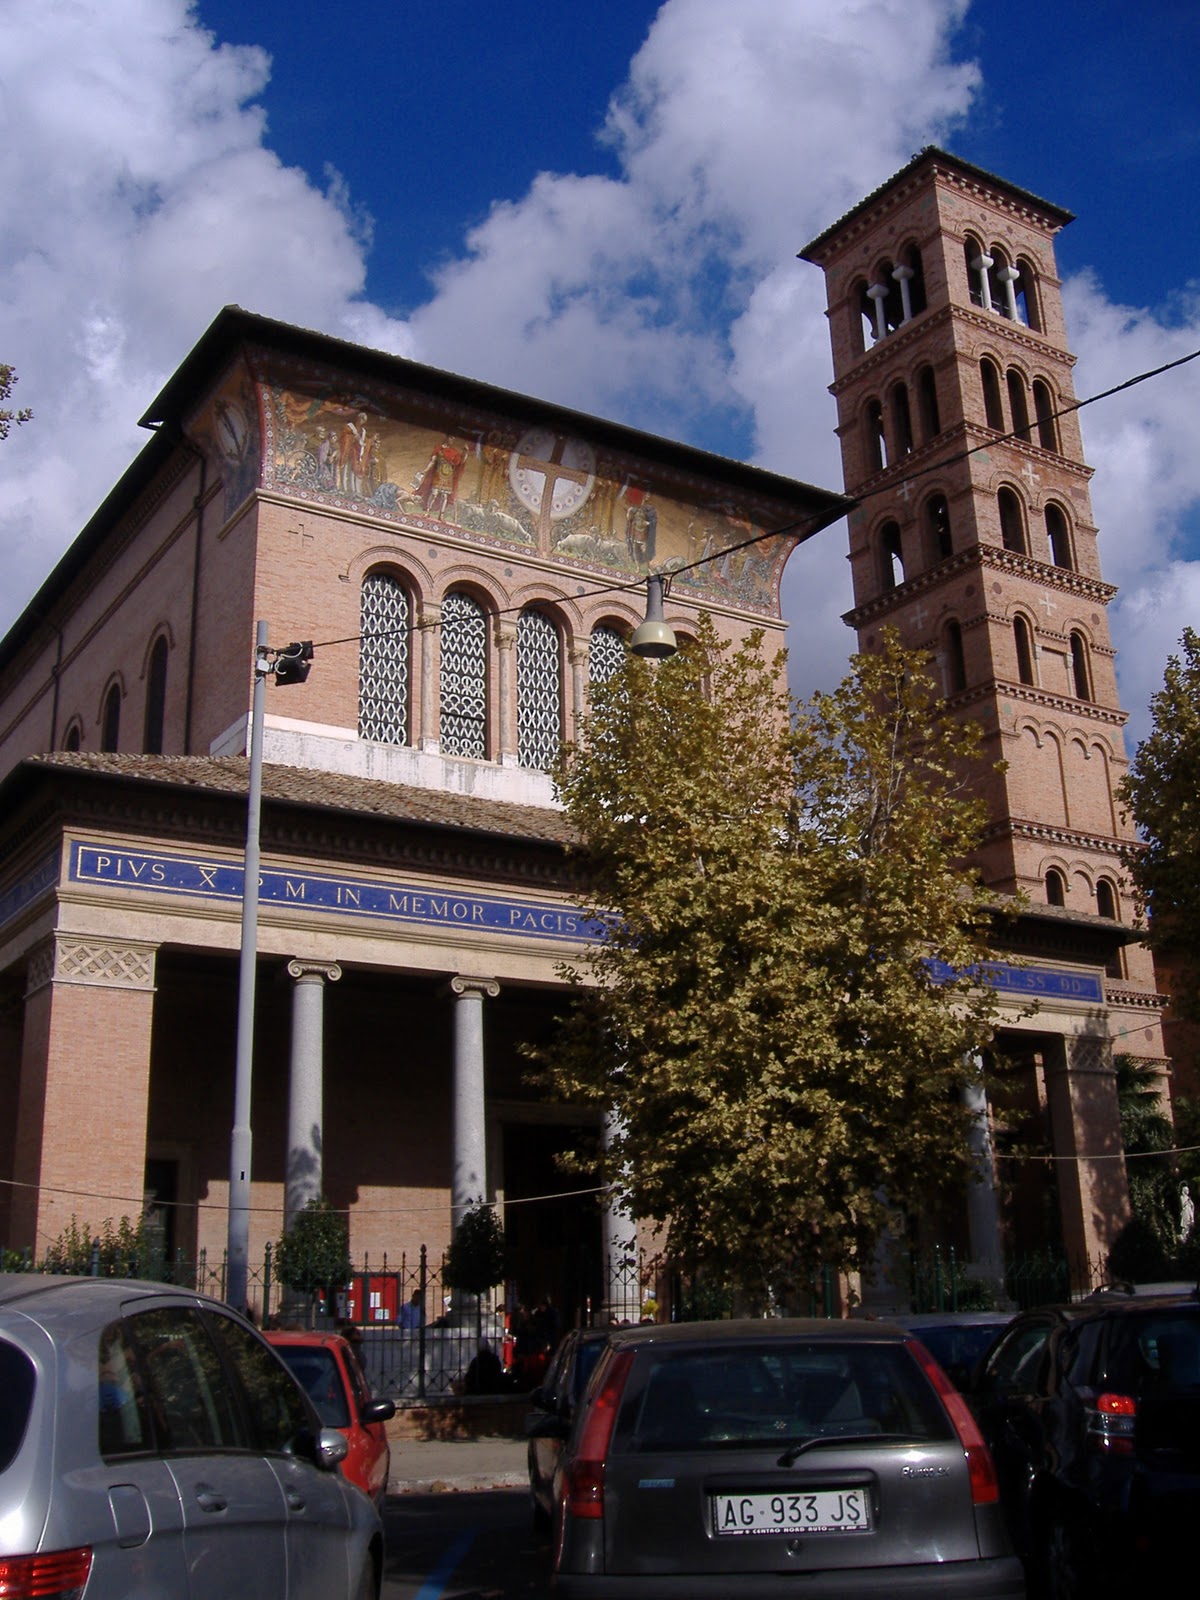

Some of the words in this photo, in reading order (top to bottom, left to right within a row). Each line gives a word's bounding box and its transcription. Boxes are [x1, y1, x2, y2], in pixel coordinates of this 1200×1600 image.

[97, 856, 166, 881] PIVS
[286, 881, 306, 899] M
[336, 887, 361, 905] IN
[389, 894, 484, 921] MEMOR
[510, 910, 577, 933] PACIS
[1026, 975, 1046, 988] SS
[724, 1499, 754, 1526] AG
[771, 1496, 818, 1523] 933
[831, 1494, 860, 1522] JS
